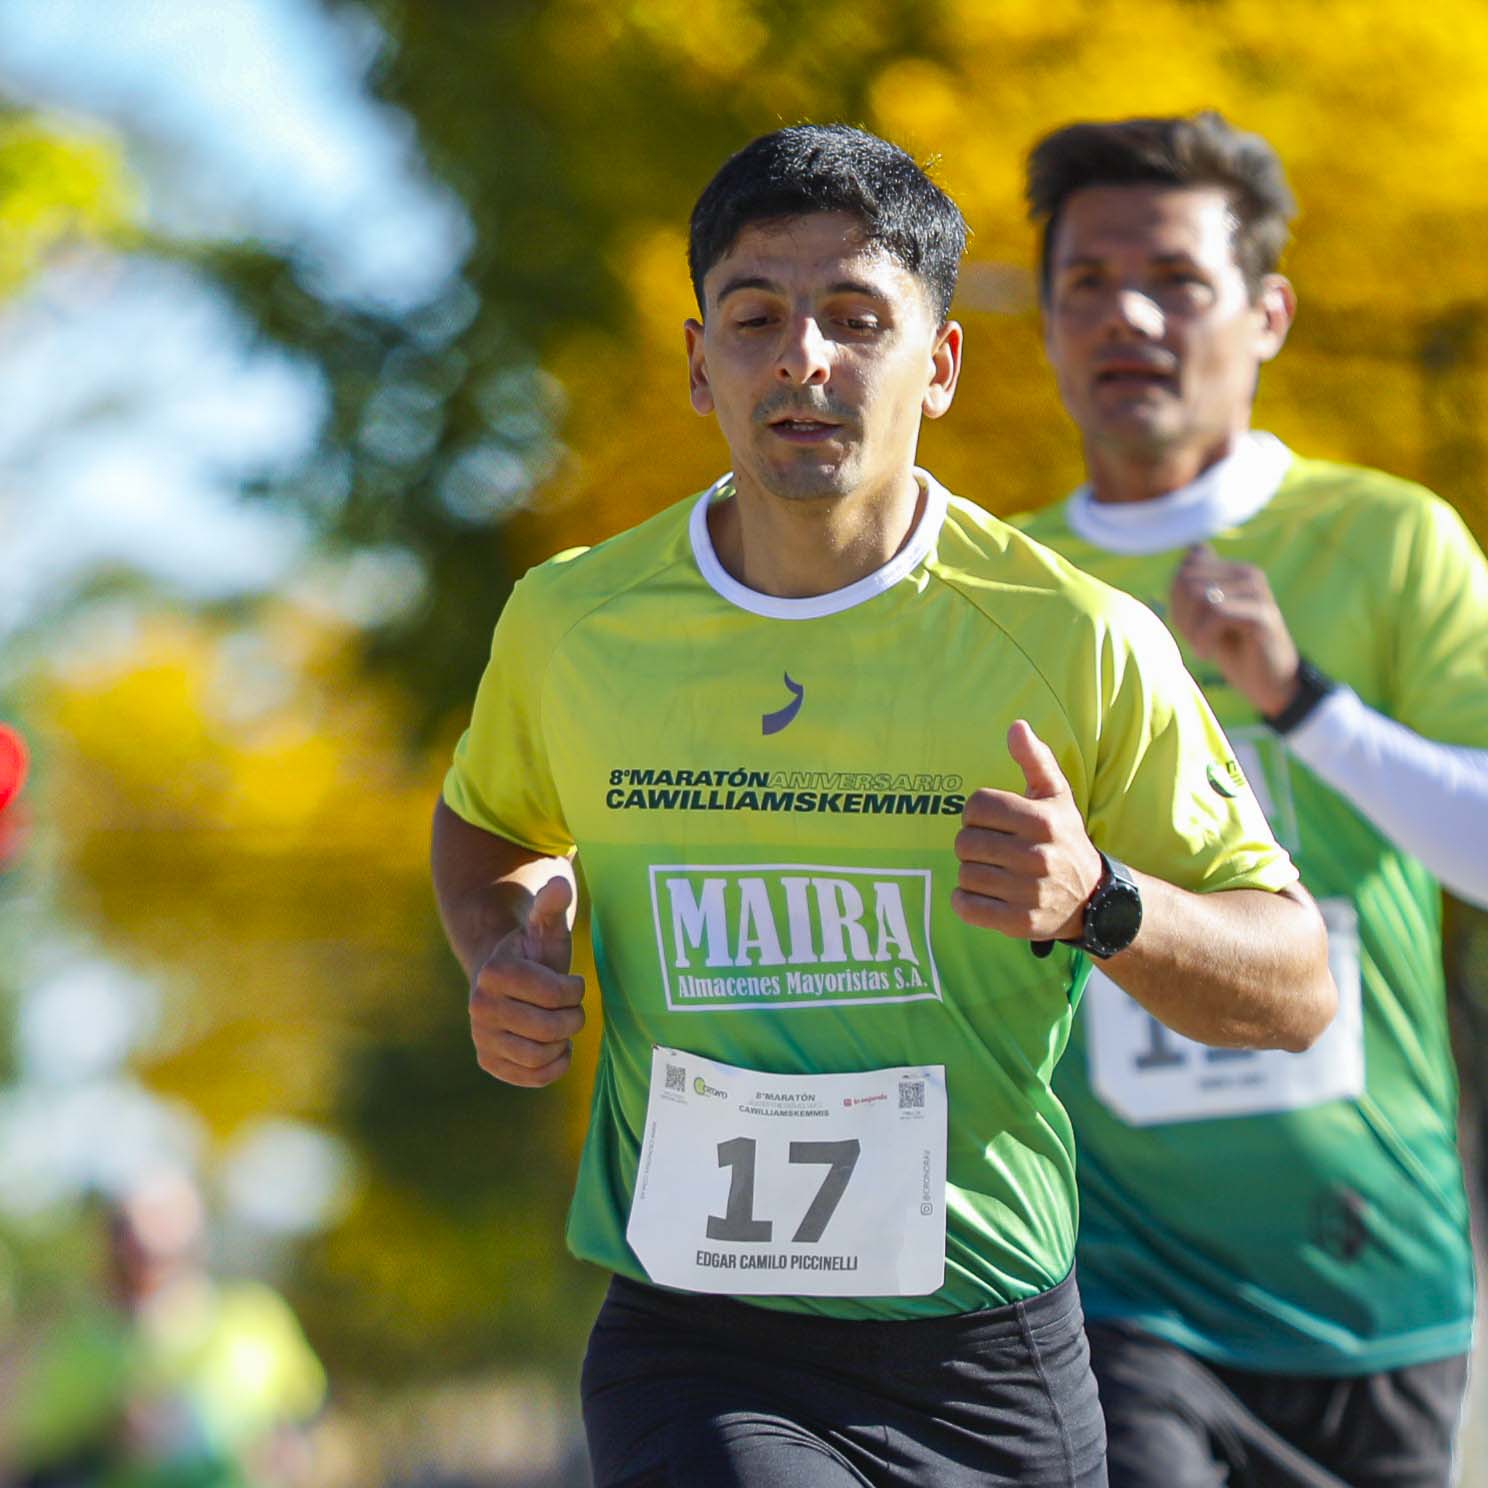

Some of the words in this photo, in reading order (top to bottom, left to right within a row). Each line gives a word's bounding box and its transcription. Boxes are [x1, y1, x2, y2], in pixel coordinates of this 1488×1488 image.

[606, 788, 965, 816] CAWILLIAMSKEMMIS
[665, 876, 920, 969] MAIRA
[678, 973, 781, 998] Almacenes
[785, 968, 890, 996] Mayoristas
[893, 966, 928, 990] S.A.
[706, 1136, 861, 1243] 17
[696, 1250, 736, 1270] EDGAR
[739, 1254, 788, 1270] CAMILO
[790, 1254, 858, 1271] PICCINELLI
